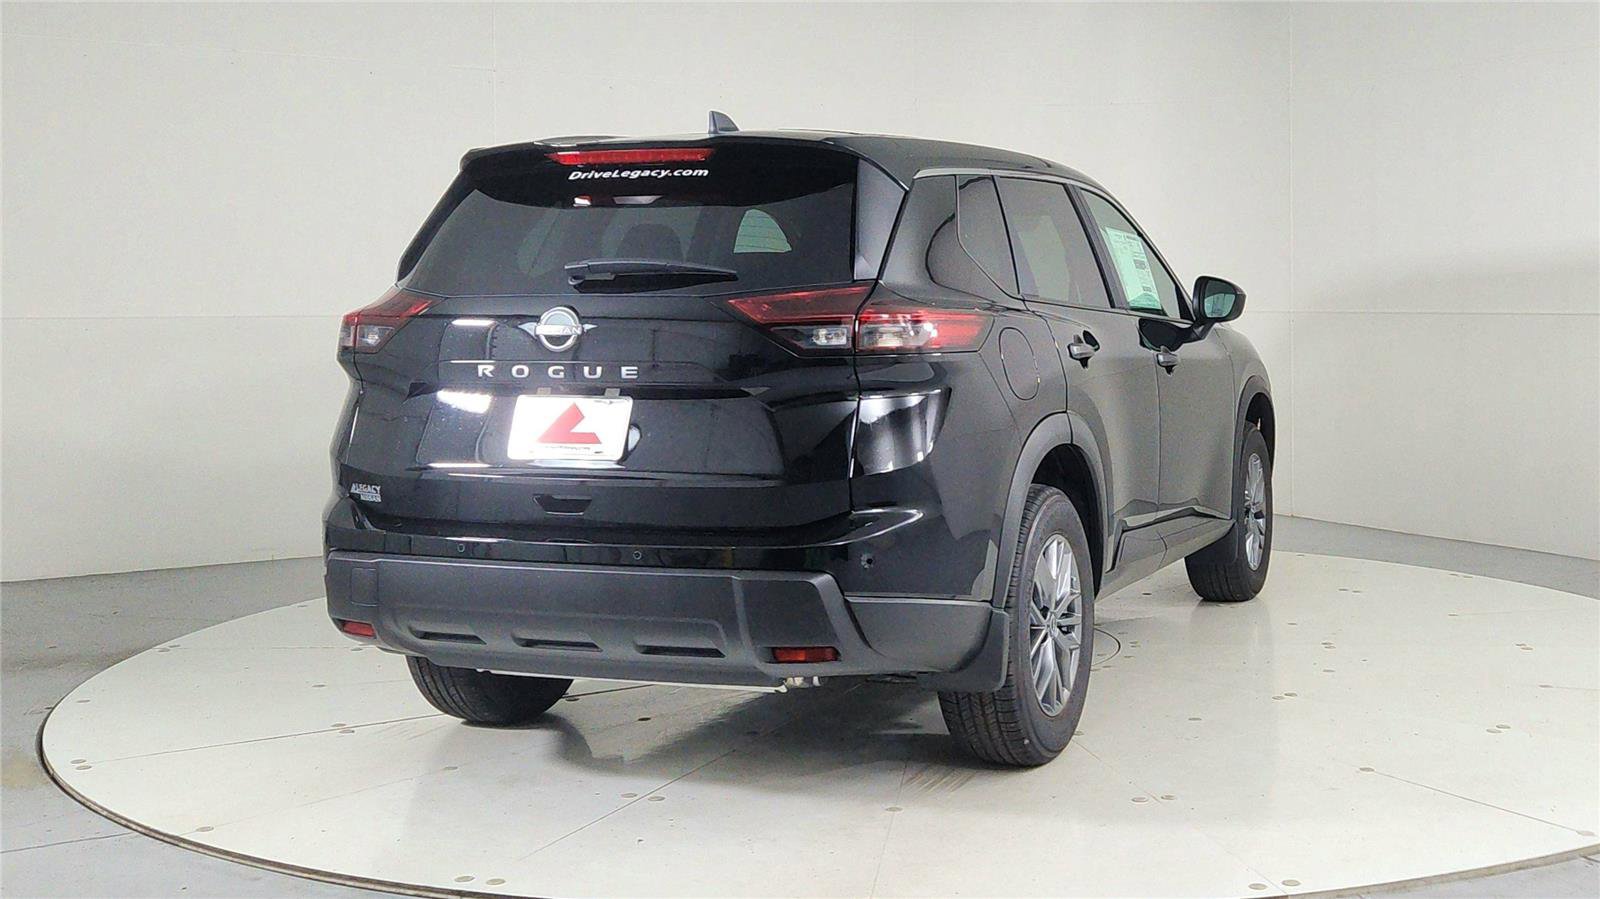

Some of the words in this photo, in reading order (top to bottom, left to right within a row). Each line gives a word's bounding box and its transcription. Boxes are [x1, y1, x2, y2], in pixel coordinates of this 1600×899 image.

[568, 168, 709, 181] DriveLegacy.com
[477, 364, 639, 379] ROGUE
[356, 483, 381, 494] LEGACY
